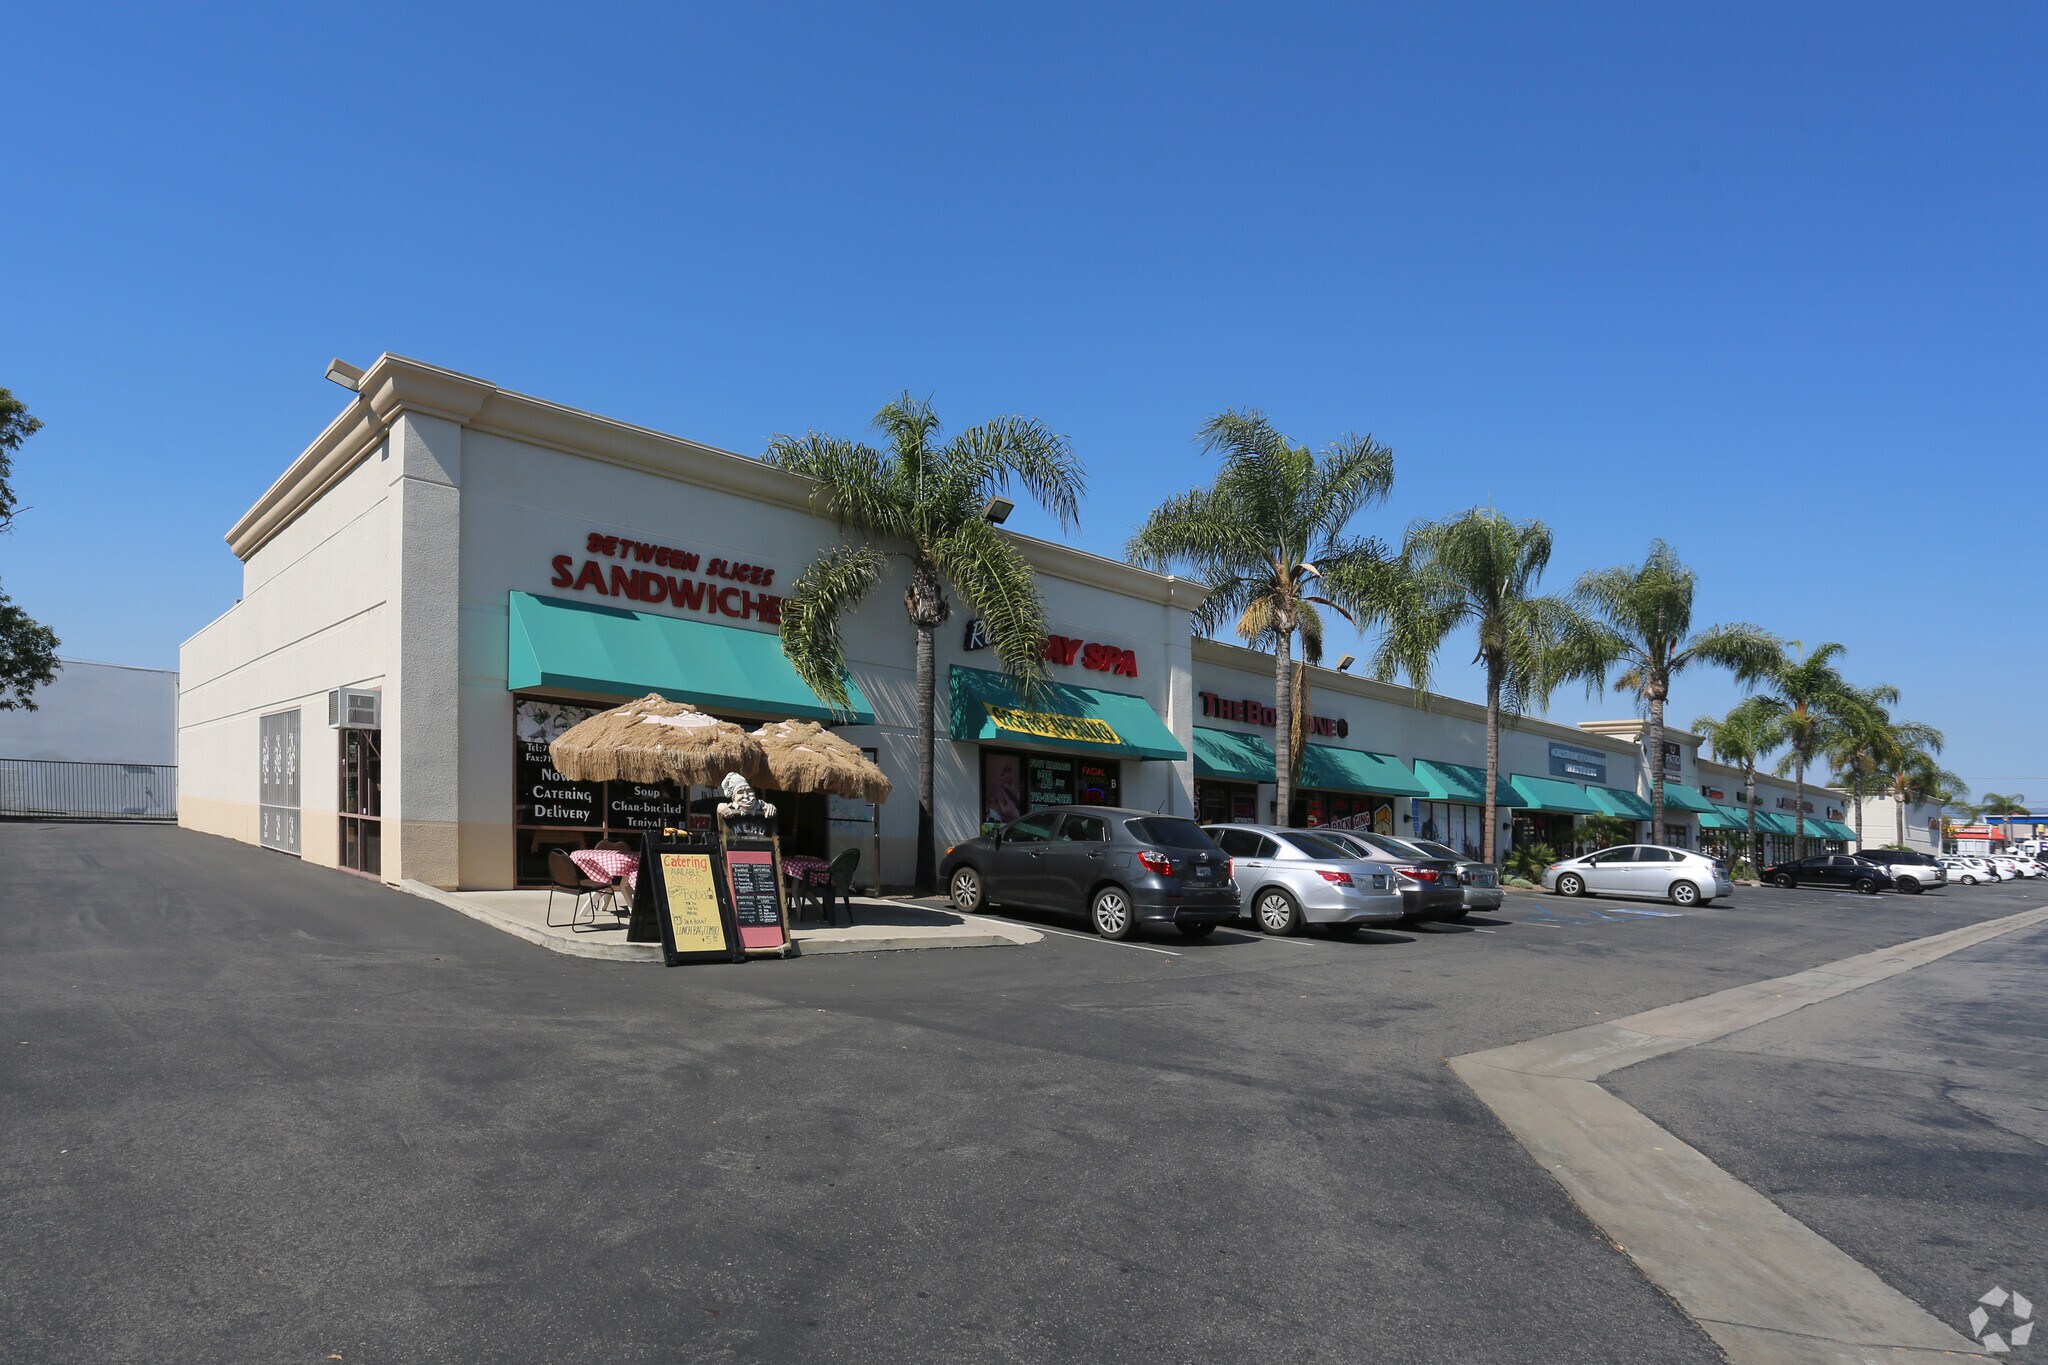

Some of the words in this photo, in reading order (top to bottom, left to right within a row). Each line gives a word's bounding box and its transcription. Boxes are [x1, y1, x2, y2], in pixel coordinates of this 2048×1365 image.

[586, 532, 700, 572] BETWEEN
[705, 557, 775, 587] SLICES
[551, 554, 784, 625] SANDWICHE
[1042, 634, 1084, 666] AY
[1081, 642, 1138, 677] SPA
[1198, 691, 1245, 722] THE
[1245, 700, 1278, 727] BO
[1048, 716, 1115, 742] OPENING
[1081, 766, 1105, 776] FACIAL
[634, 786, 660, 798] Soup
[1111, 779, 1116, 788] B
[532, 785, 592, 803] Catering
[534, 804, 590, 822] Delivery
[663, 855, 708, 872] Catering
[683, 888, 708, 901] Boba
